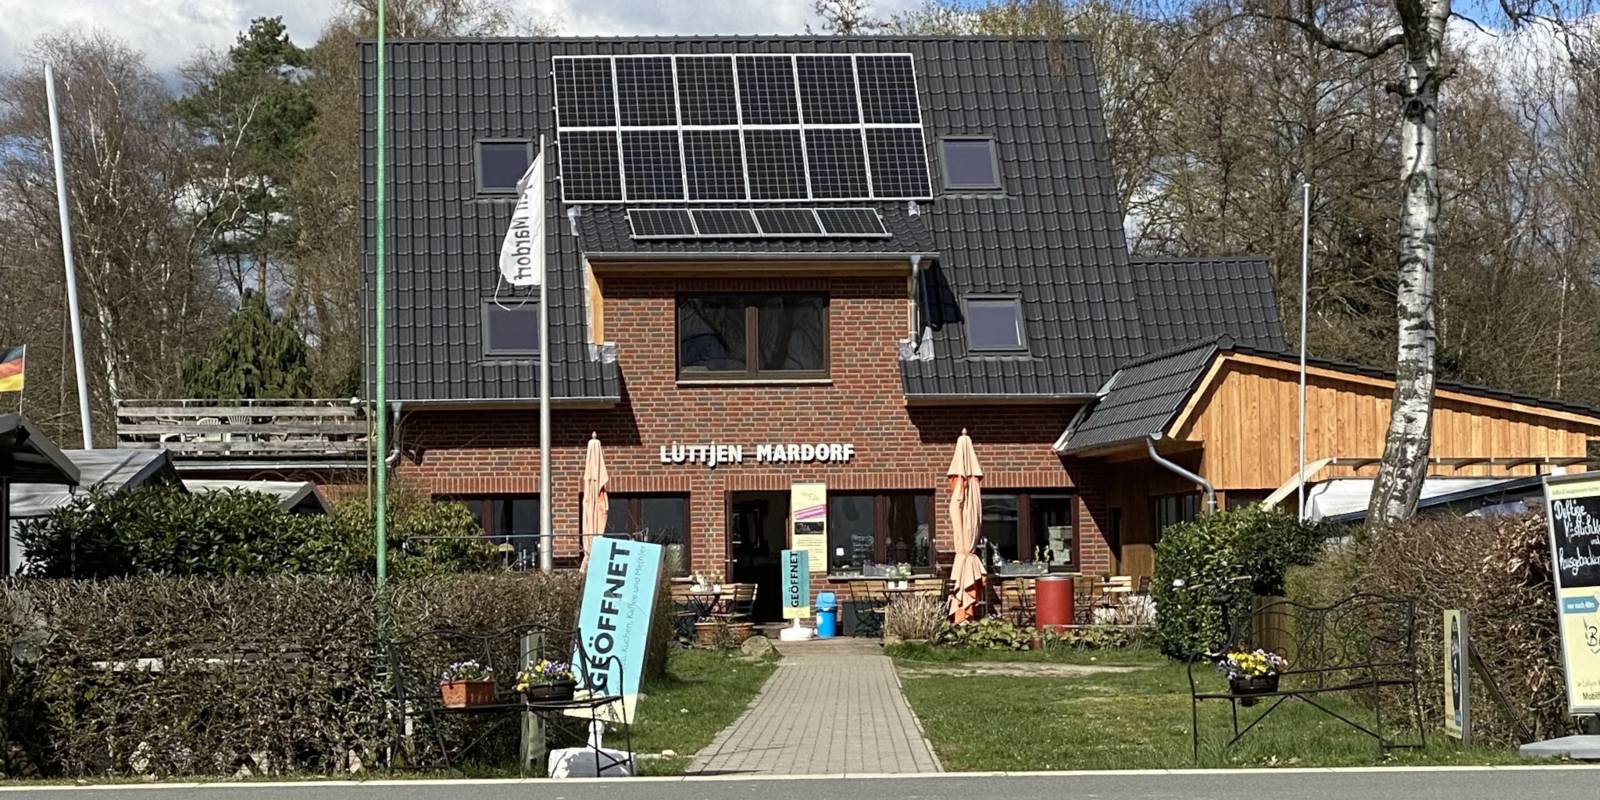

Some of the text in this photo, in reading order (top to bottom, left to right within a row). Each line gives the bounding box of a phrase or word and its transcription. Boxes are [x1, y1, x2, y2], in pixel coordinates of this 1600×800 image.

[756, 443, 854, 462] MARDORF
[1553, 499, 1587, 522] Deftige
[633, 577, 641, 593] und
[789, 551, 799, 608] GEÖFFNET
[589, 542, 630, 692] GEÖFFNET
